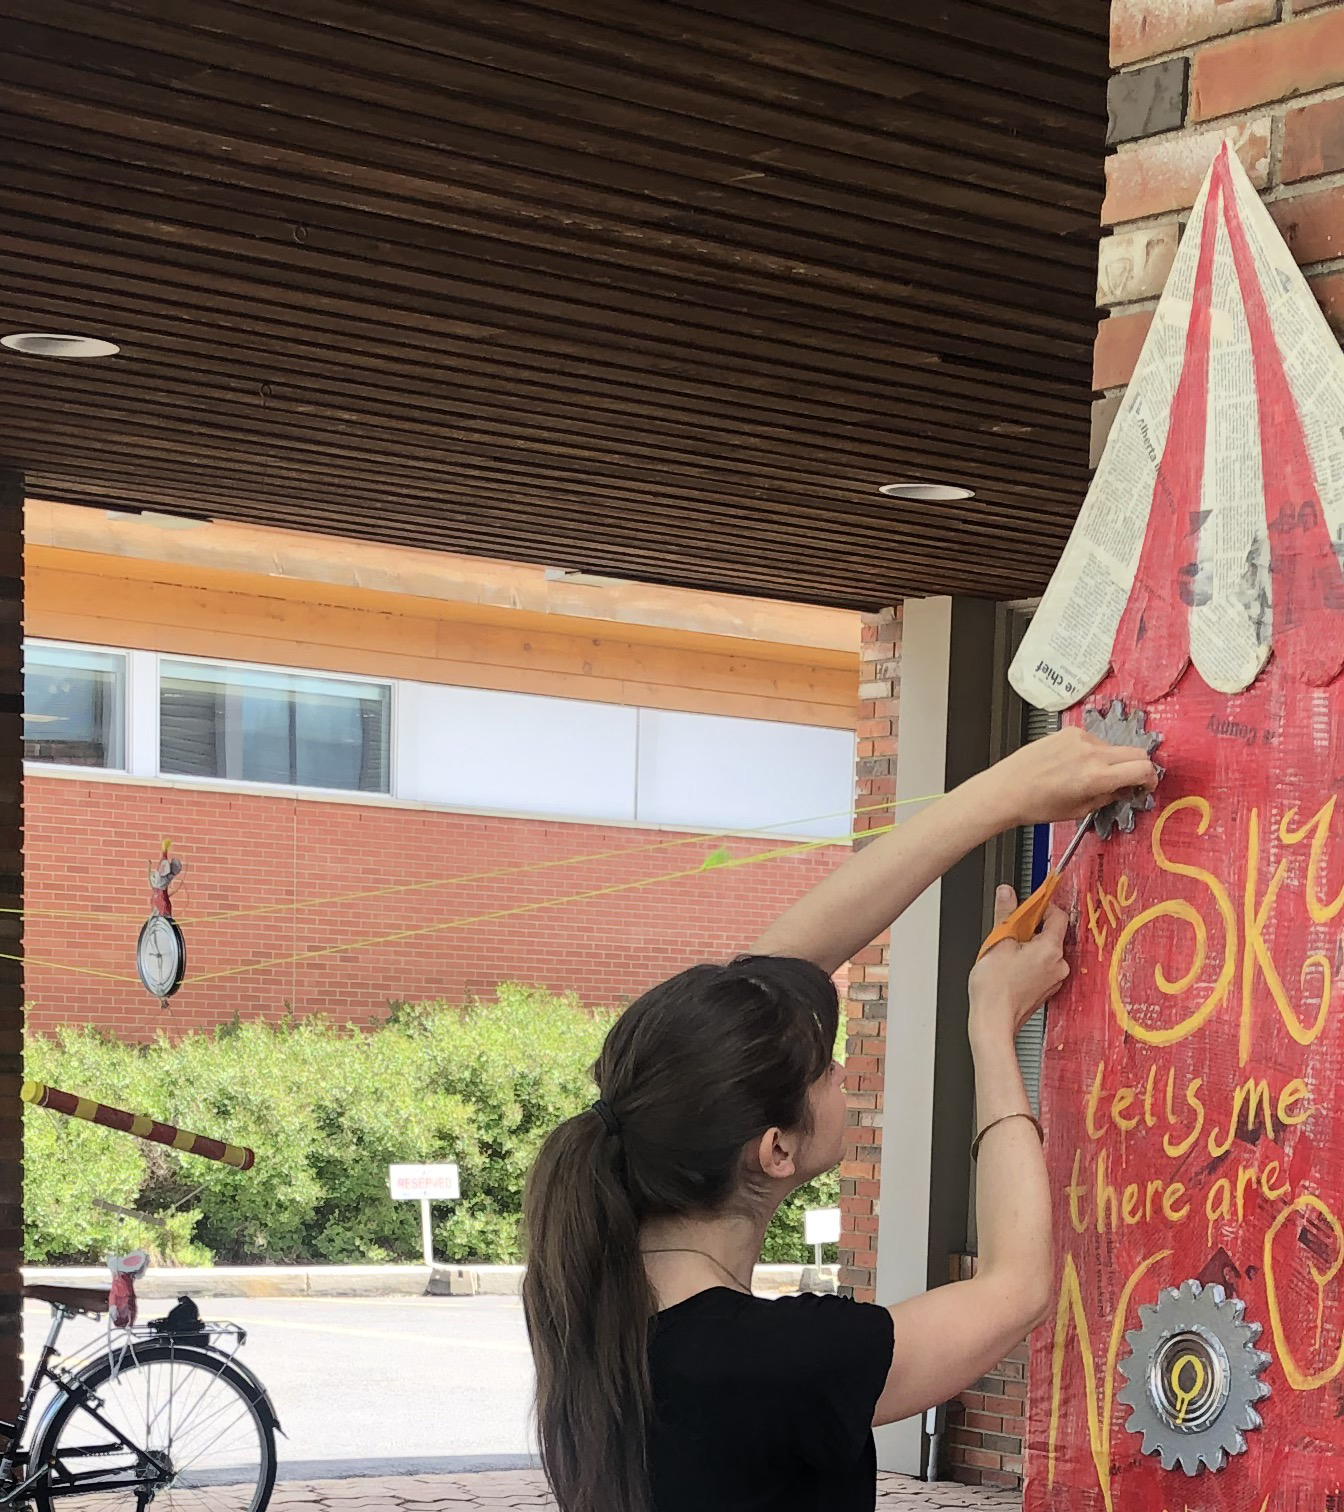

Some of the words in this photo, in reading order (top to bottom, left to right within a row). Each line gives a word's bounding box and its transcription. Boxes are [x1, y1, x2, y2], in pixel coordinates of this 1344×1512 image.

[1086, 875, 1138, 960] the
[1084, 1061, 1205, 1158] tells
[1208, 1076, 1314, 1158] me
[1065, 1148, 1190, 1234] there
[1205, 1160, 1290, 1226] are
